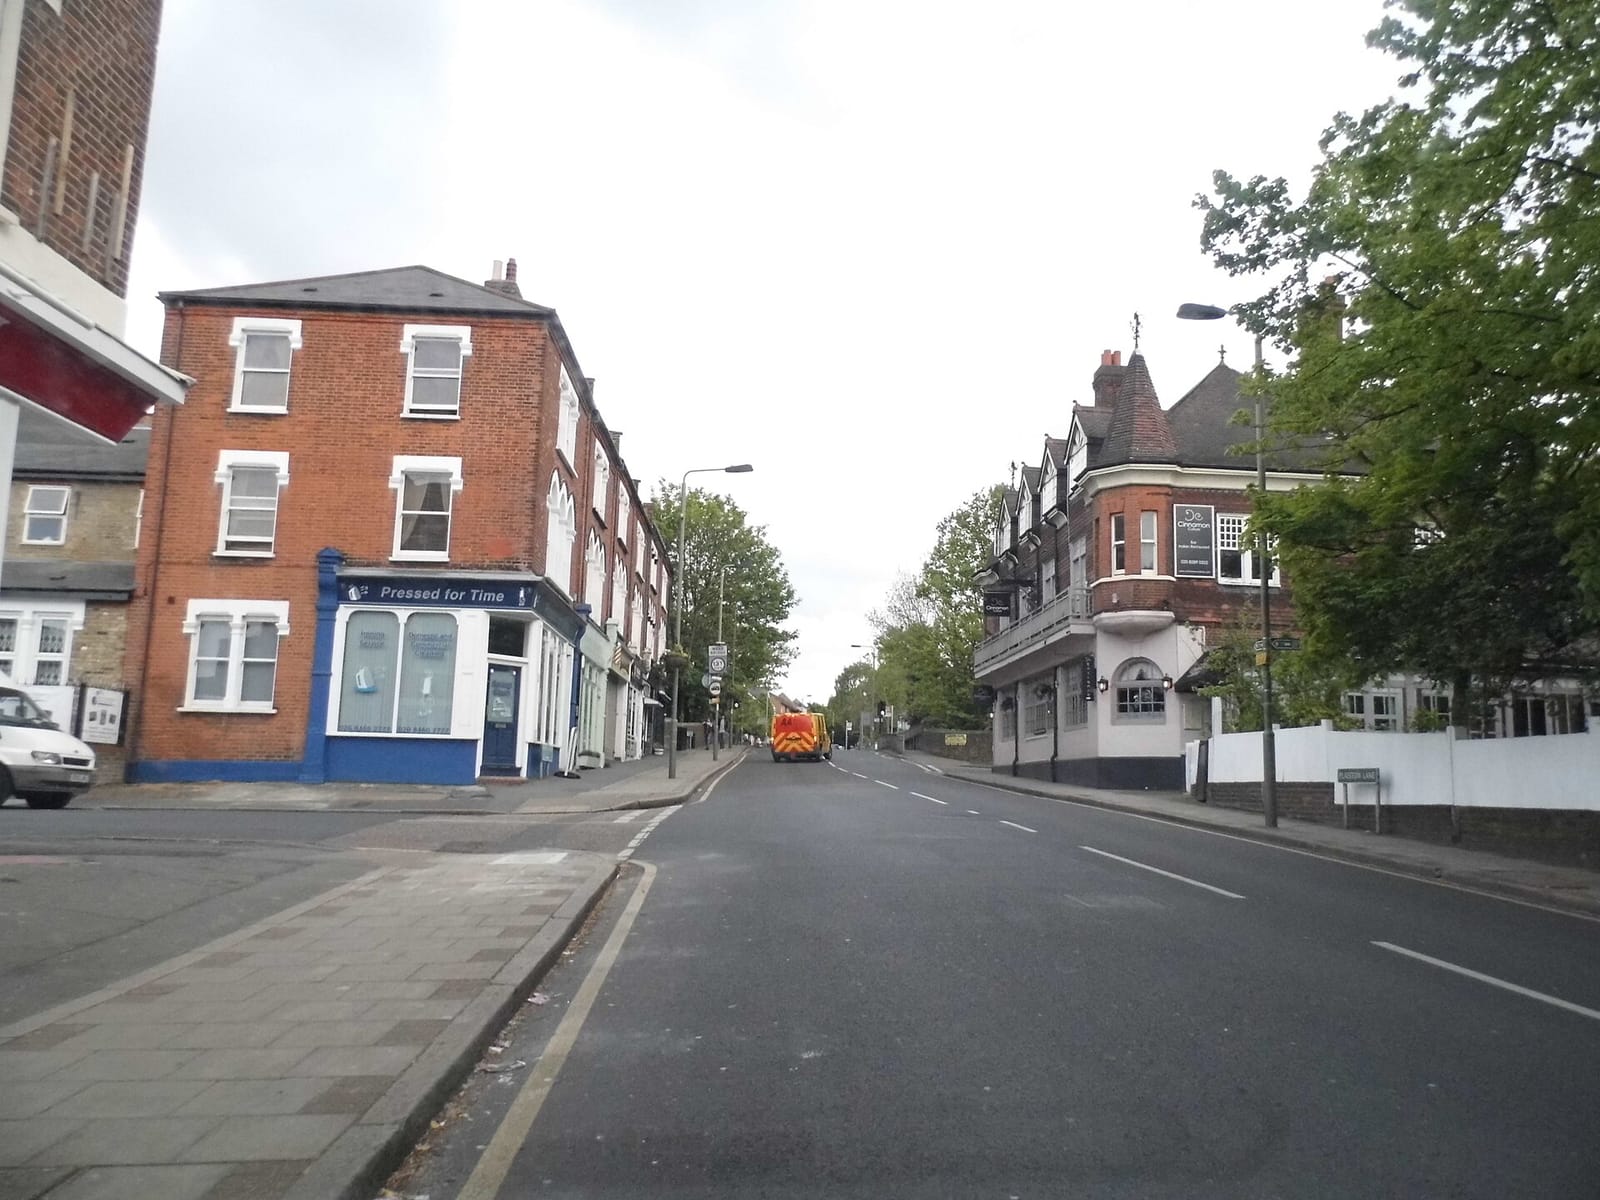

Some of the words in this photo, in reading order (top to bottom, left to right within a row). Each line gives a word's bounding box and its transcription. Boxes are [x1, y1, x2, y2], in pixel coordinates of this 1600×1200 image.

[1178, 520, 1210, 529] Cinnamon
[380, 586, 441, 600] Pressed
[444, 588, 466, 601] for
[470, 589, 505, 602] Time
